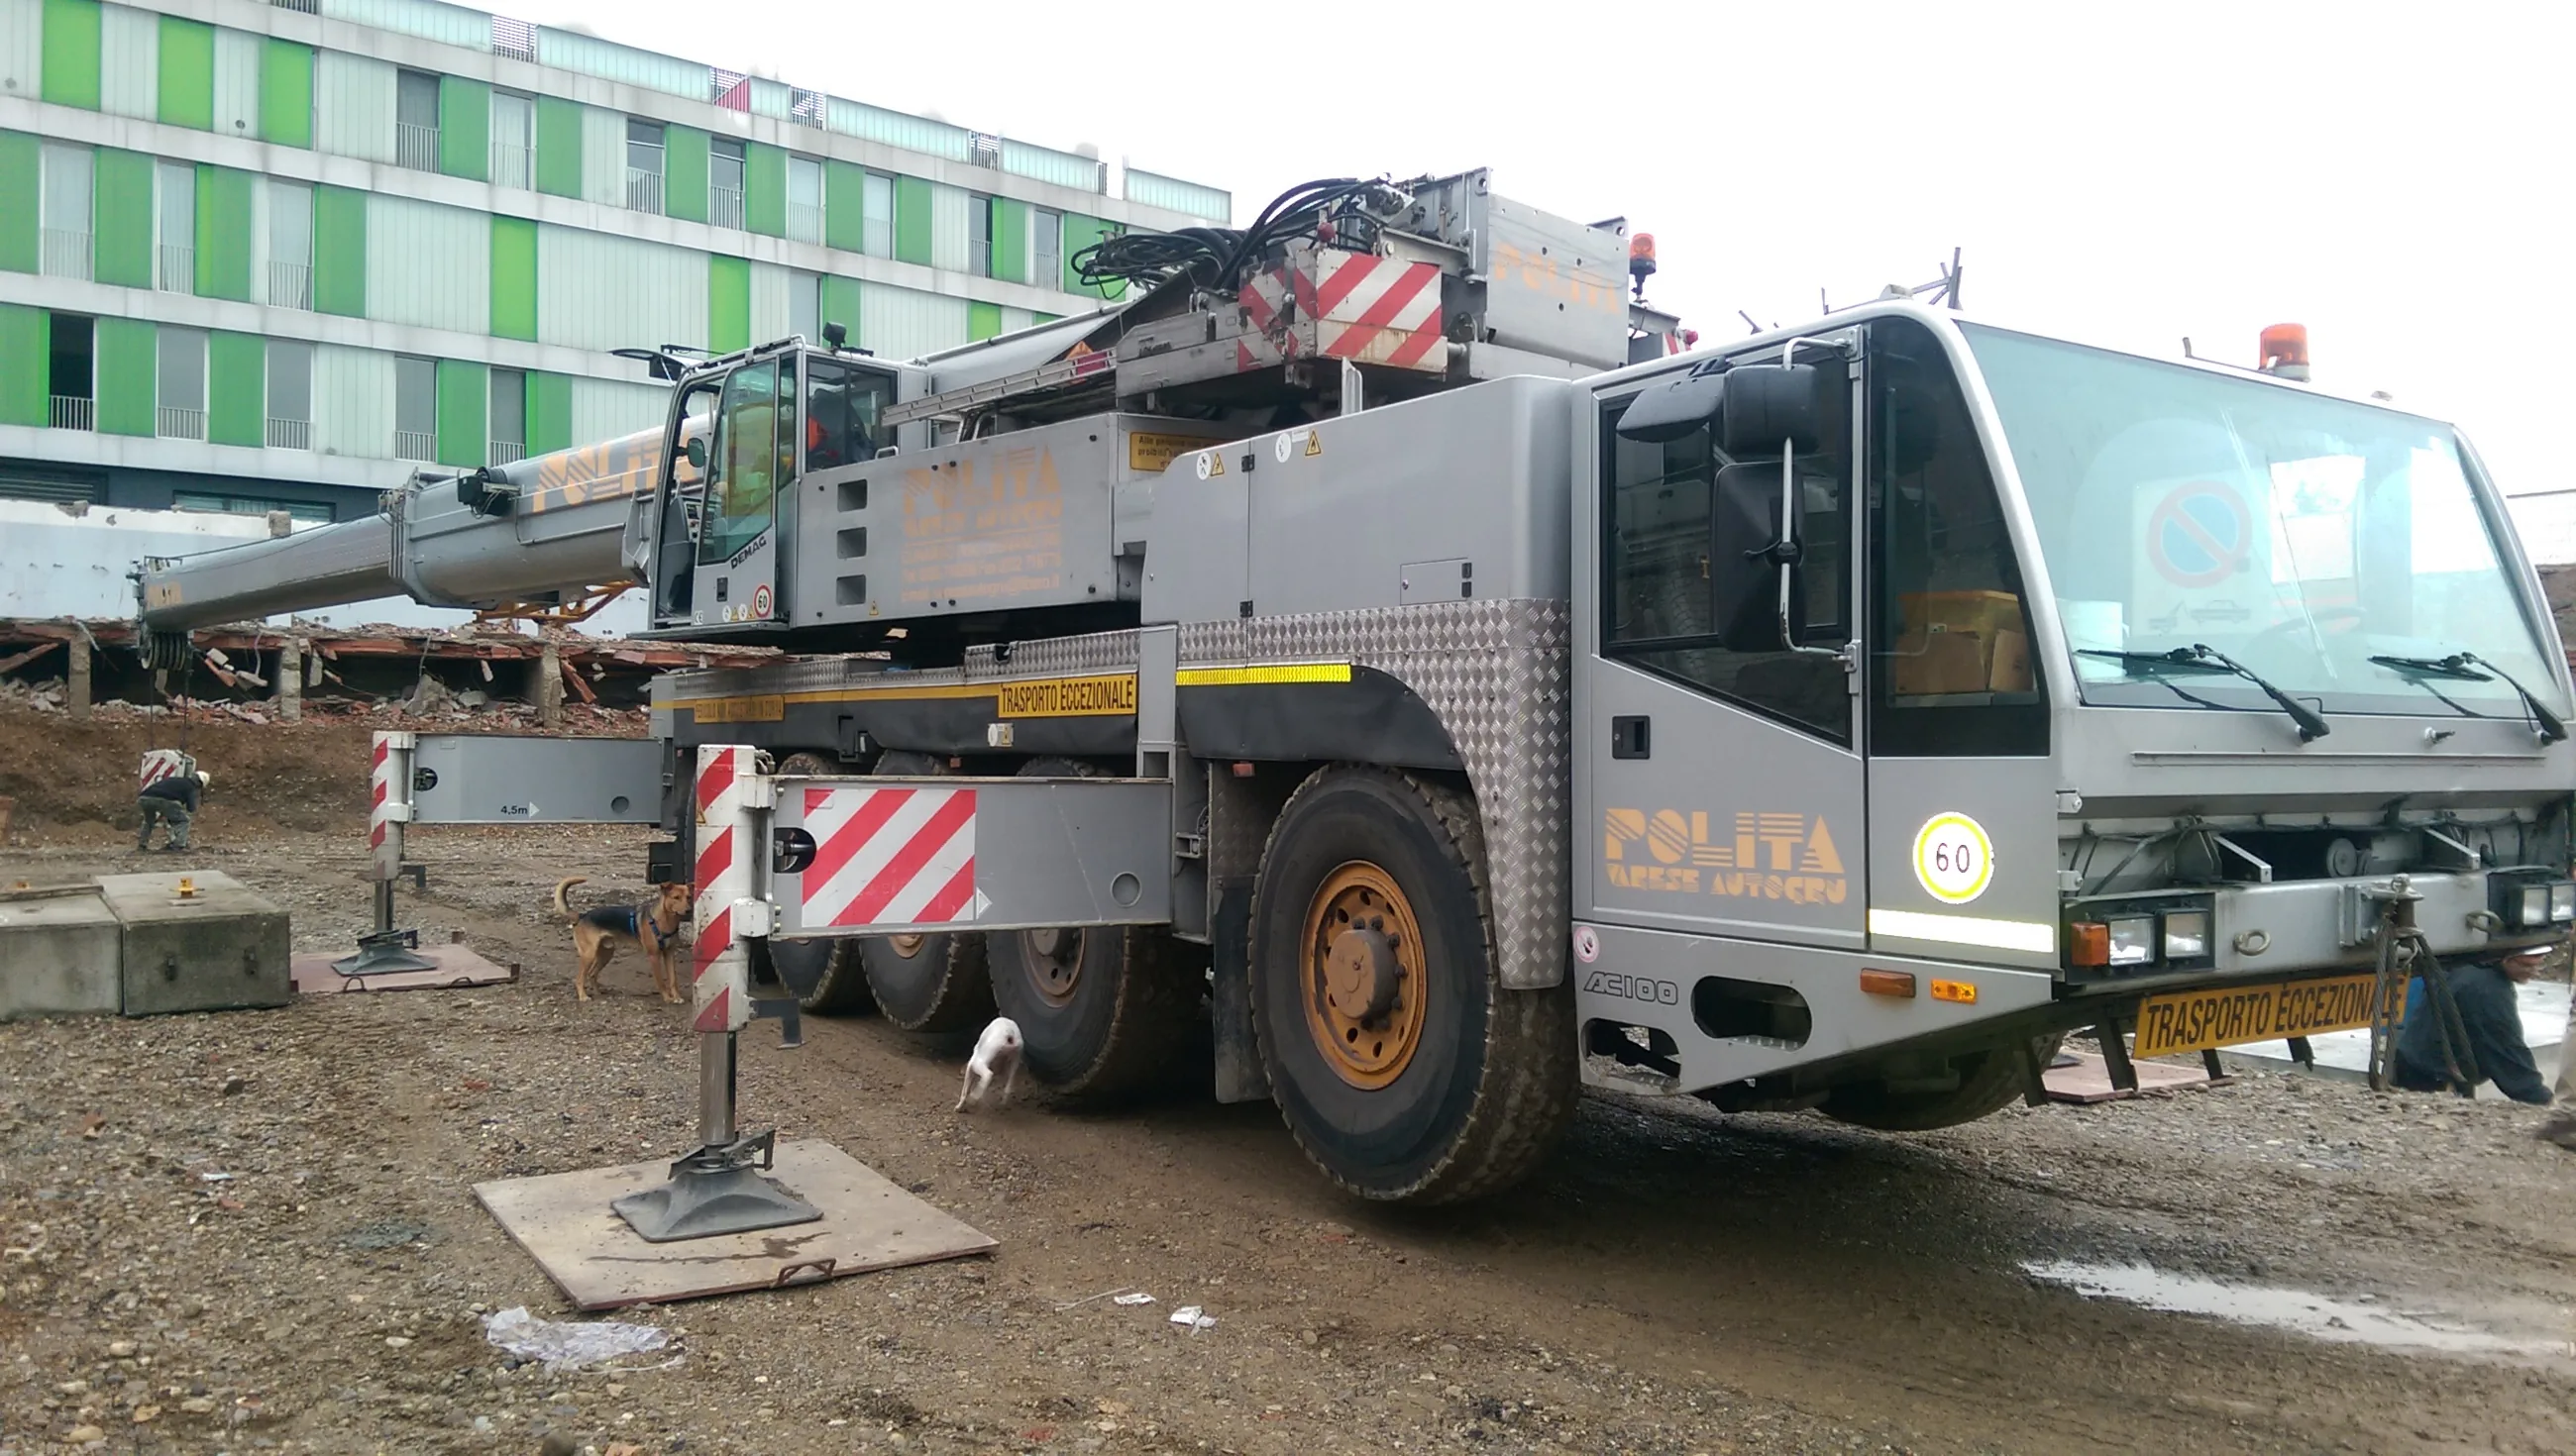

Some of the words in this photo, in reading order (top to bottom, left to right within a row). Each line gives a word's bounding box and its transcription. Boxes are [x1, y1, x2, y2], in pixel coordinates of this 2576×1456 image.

[903, 447, 1061, 516] POLITA
[730, 536, 767, 570] DEMAG
[758, 595, 768, 609] 60
[1002, 684, 1057, 712] TRASPORTO
[1060, 680, 1133, 711] ECCEZIONALE
[1605, 808, 1845, 874] POLITA
[1936, 843, 1970, 873] 60
[1606, 864, 1699, 892] VARESE
[1710, 873, 1847, 905] AUTOGRU
[1583, 971, 1678, 1005] AC100
[2146, 991, 2272, 1050] TRASPORTO
